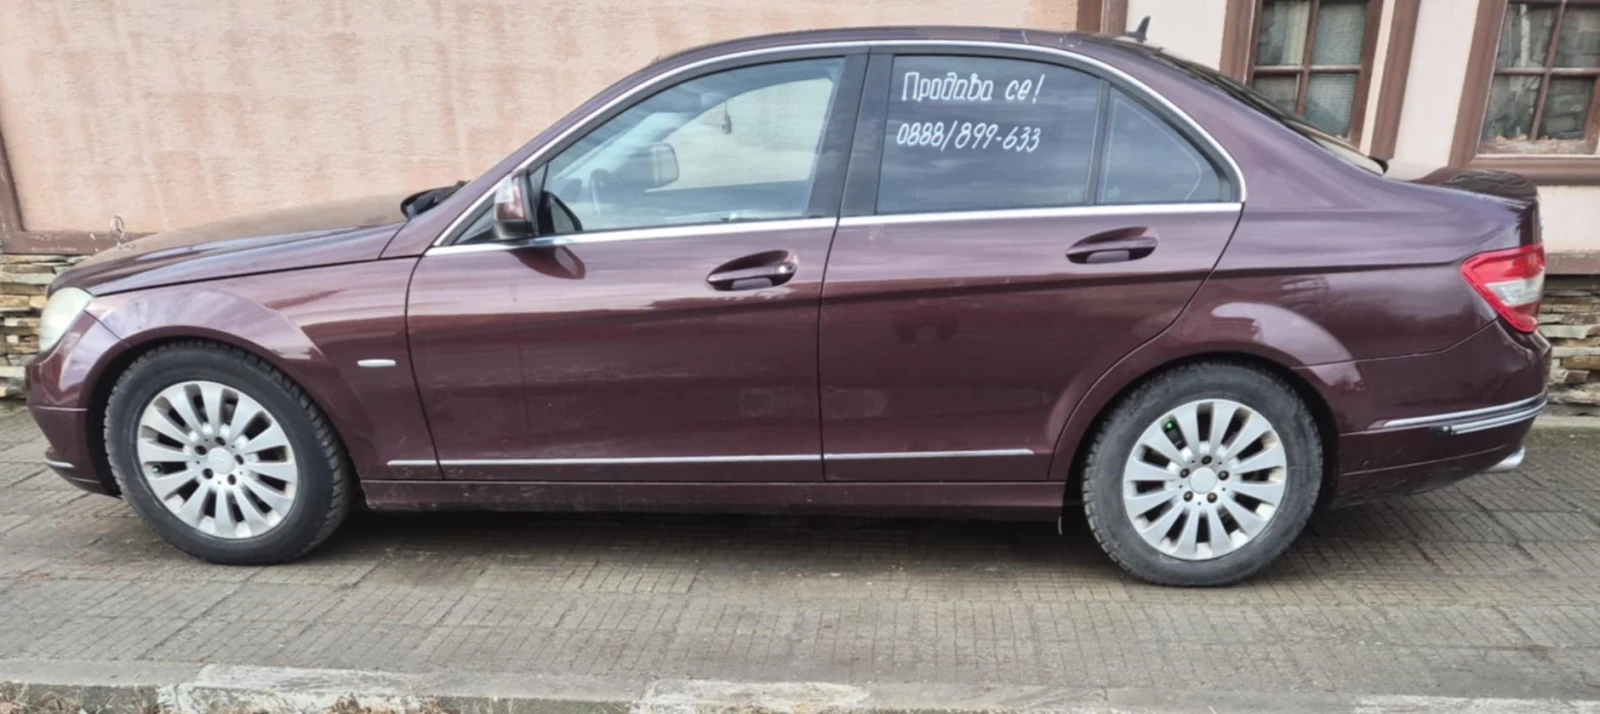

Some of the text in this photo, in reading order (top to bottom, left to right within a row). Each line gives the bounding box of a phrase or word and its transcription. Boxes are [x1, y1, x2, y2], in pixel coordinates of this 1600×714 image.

[901, 71, 1045, 104] Продава се!
[896, 120, 1041, 152] 0888/899-633
